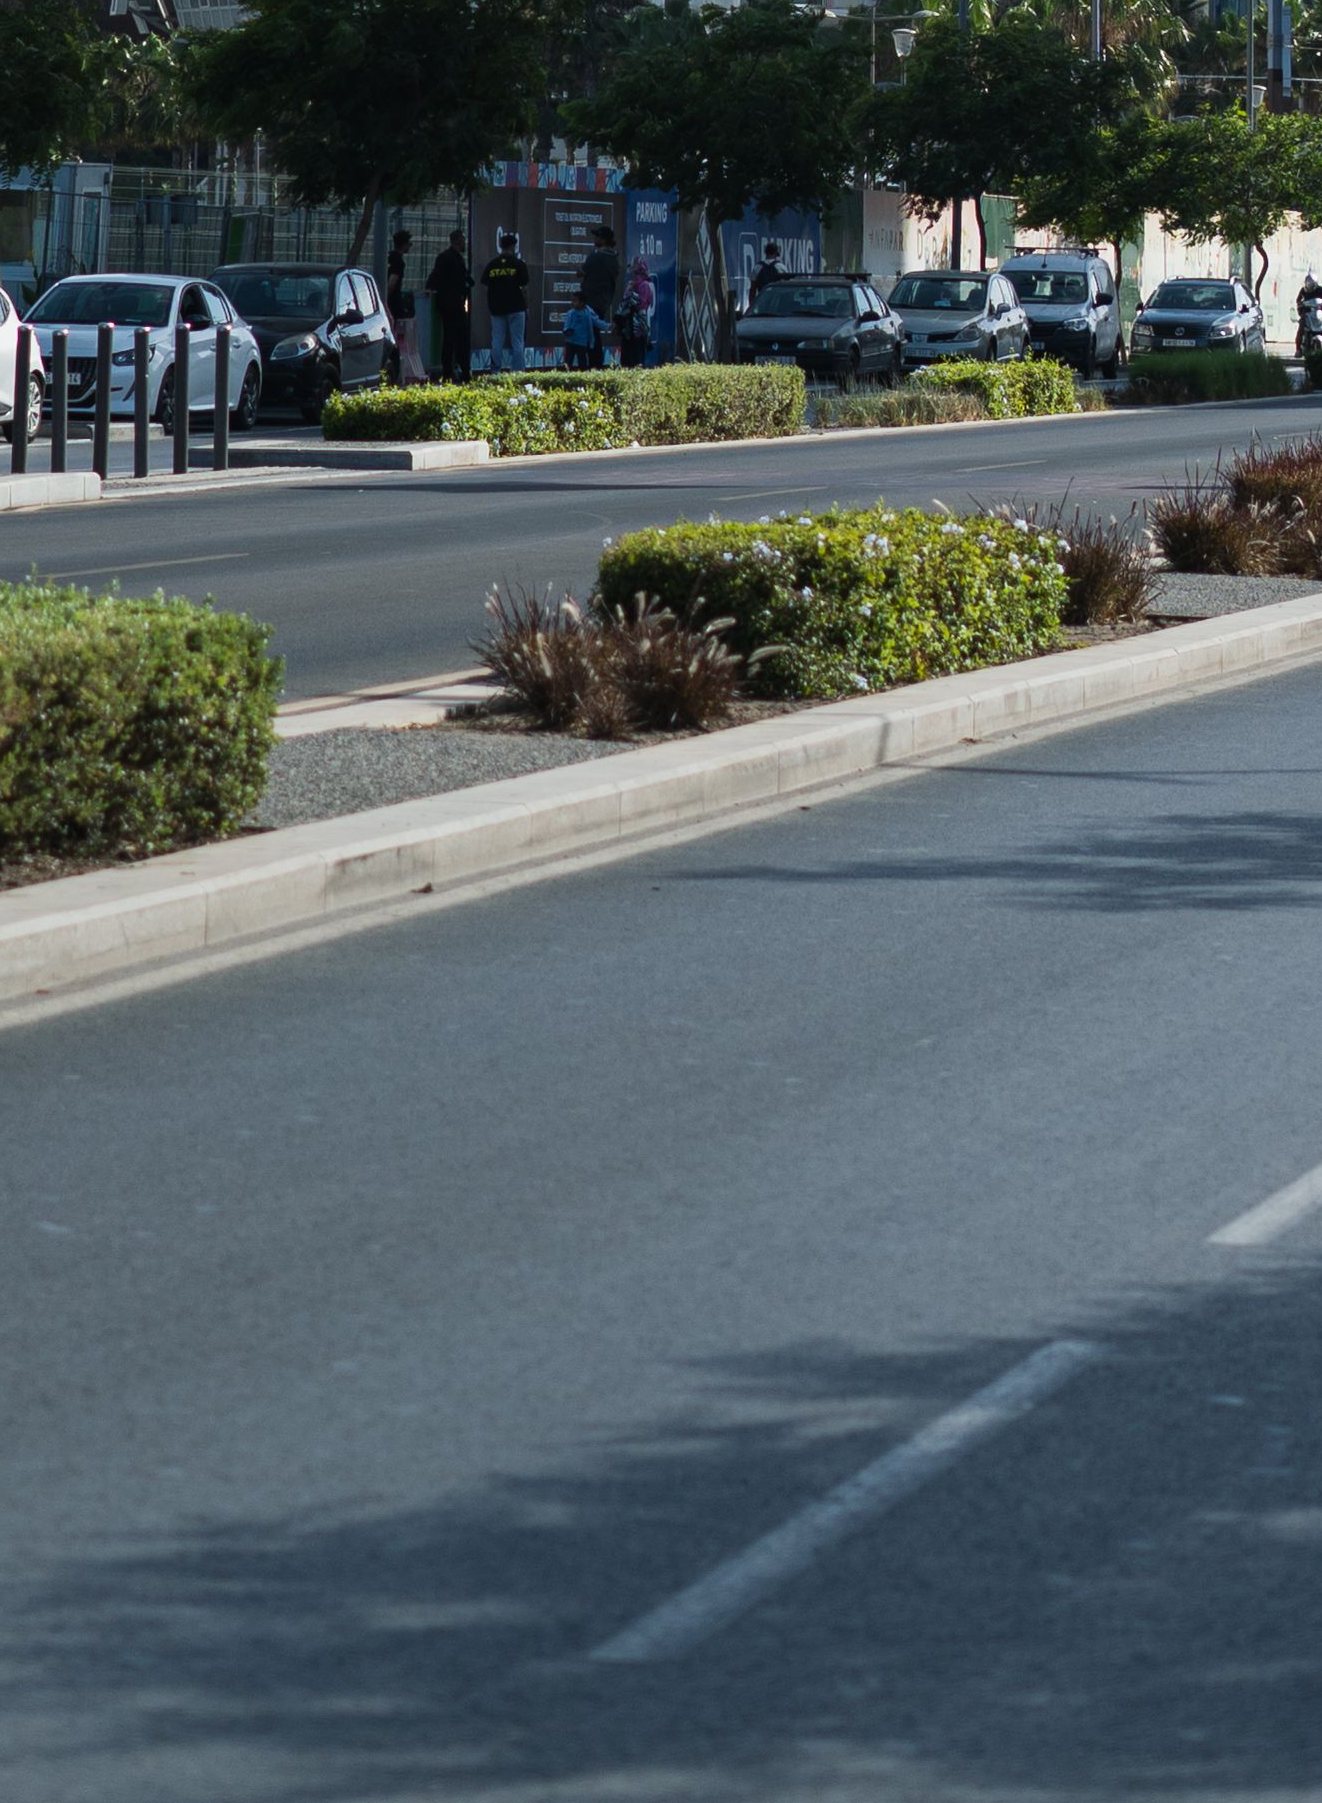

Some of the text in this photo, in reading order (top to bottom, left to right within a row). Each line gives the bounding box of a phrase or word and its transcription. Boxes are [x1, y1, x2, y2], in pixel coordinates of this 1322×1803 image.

[636, 202, 668, 224] PARKING
[646, 234, 655, 256] 10
[655, 240, 663, 255] m
